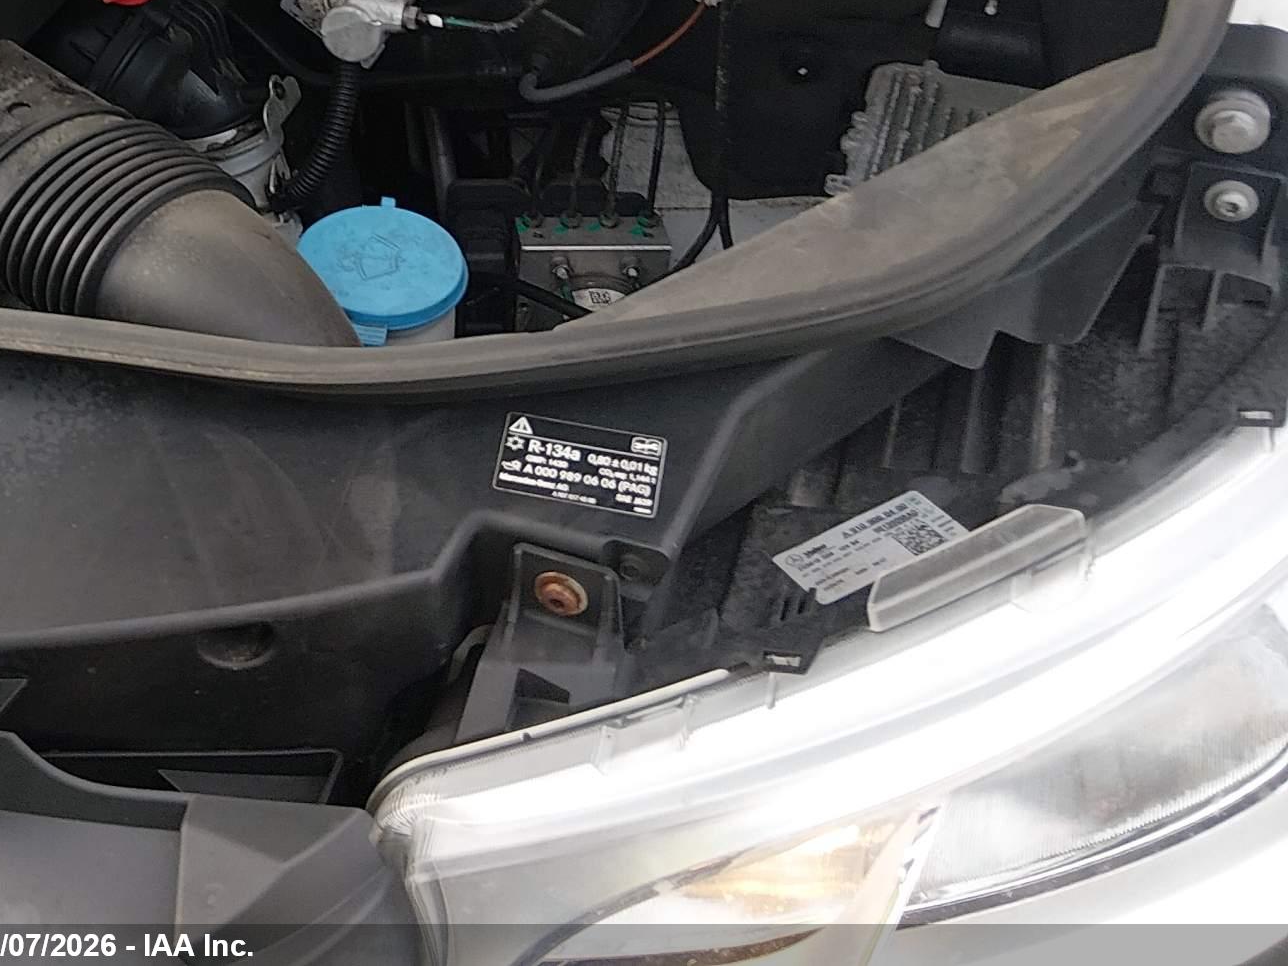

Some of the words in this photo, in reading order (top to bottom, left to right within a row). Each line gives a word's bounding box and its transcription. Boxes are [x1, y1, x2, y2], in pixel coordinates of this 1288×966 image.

[526, 439, 582, 461] R-134a
[522, 463, 534, 474] A
[534, 465, 558, 478] 000
[558, 469, 582, 483] 989
[582, 474, 599, 486] 06
[600, 478, 617, 489] 06
[617, 481, 651, 497] (PAG)
[643, 463, 658, 476] kg
